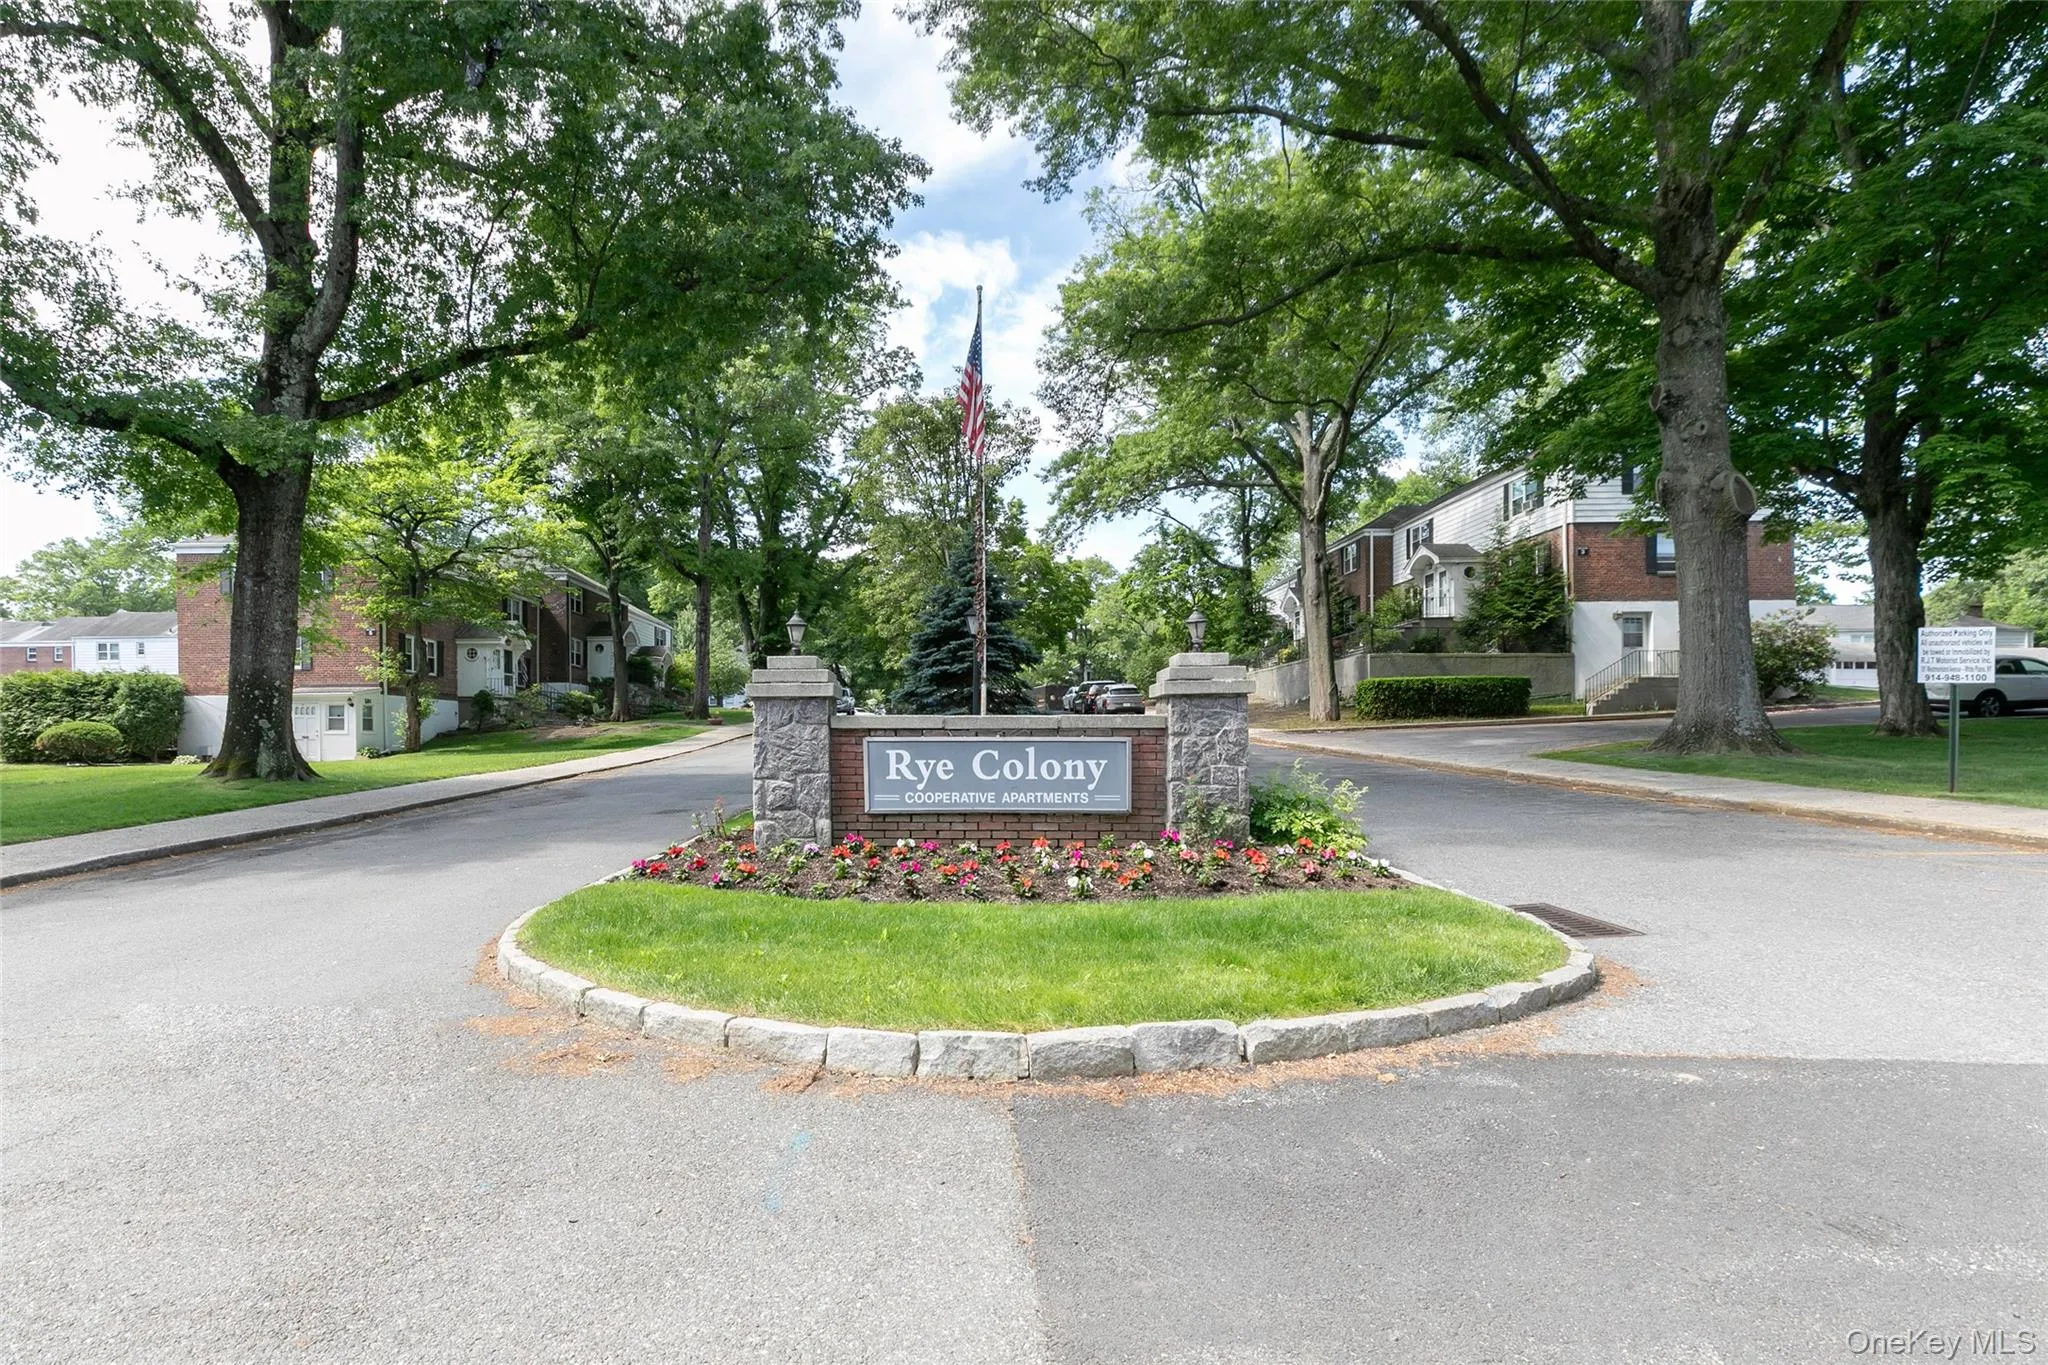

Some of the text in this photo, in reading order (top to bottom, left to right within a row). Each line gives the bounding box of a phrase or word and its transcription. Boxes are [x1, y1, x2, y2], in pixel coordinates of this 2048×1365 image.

[1954, 630, 1976, 638] Parking
[1978, 629, 1993, 637] Only
[885, 746, 1108, 790] Rye Colony
[905, 791, 1089, 804] COOPERATIVE APARTMENTS
